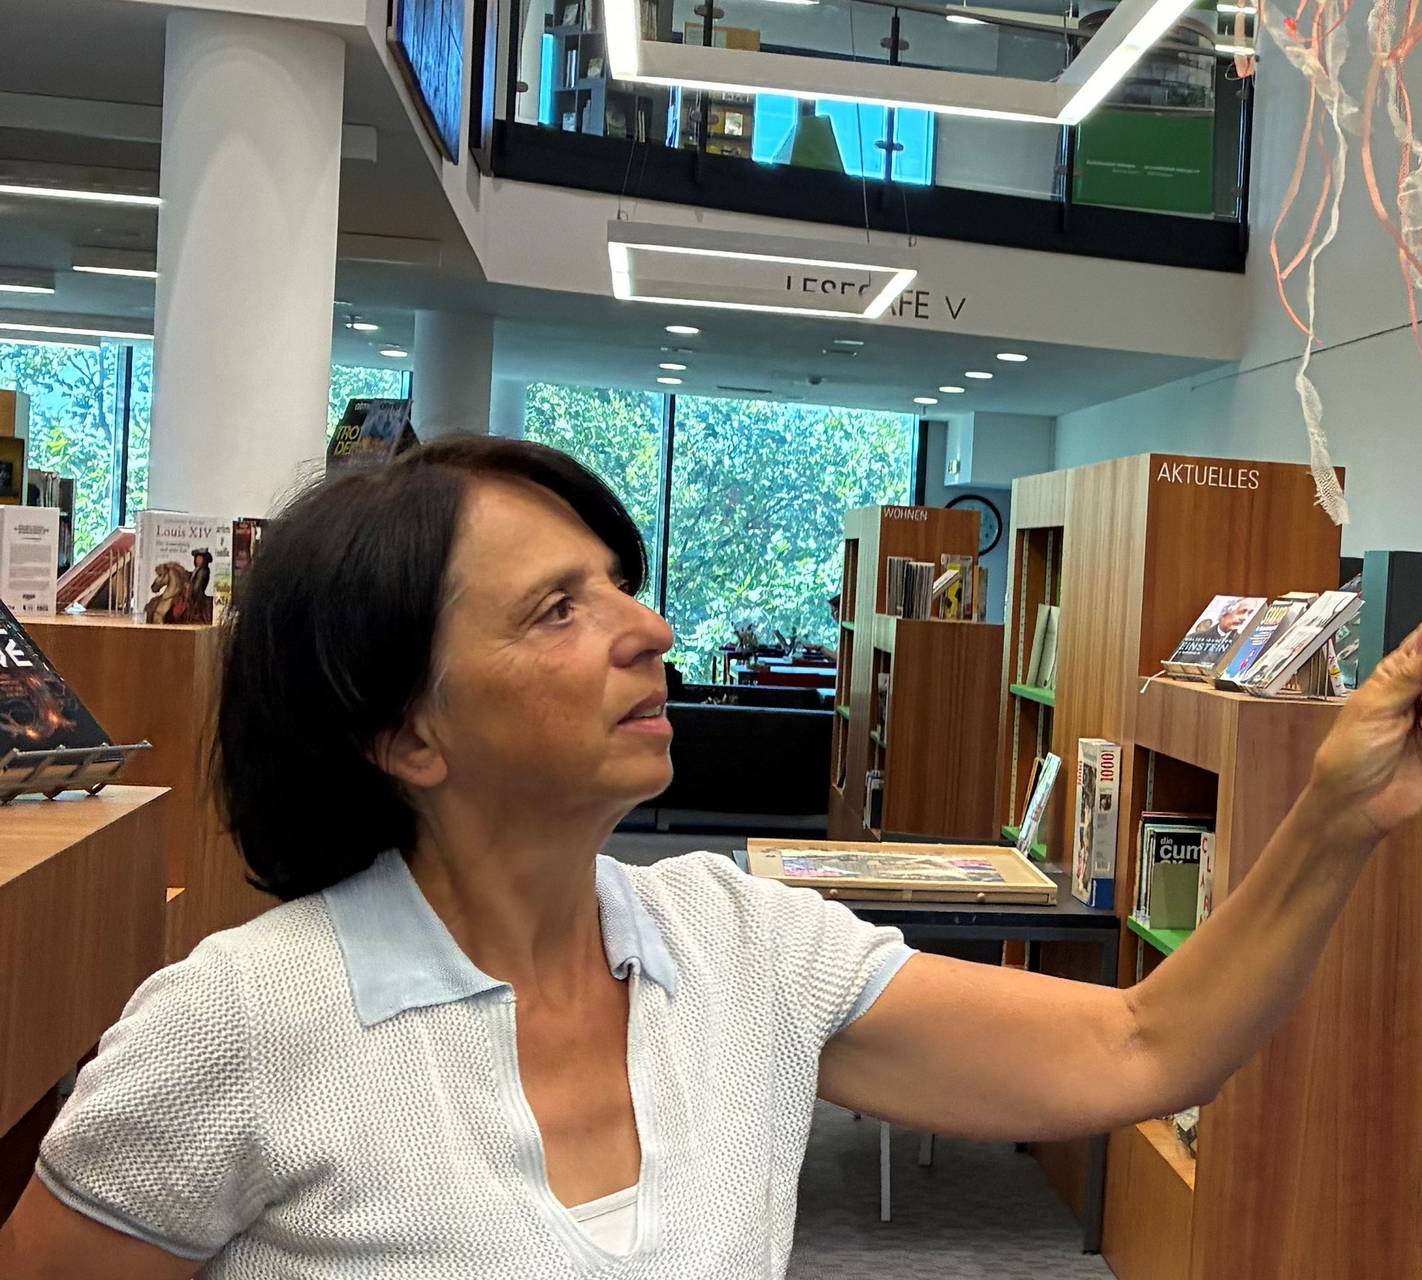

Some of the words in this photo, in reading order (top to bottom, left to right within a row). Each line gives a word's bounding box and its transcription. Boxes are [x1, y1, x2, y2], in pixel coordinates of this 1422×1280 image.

[786, 275, 930, 319] LESFE
[1157, 462, 1260, 489] AKTUELLES
[883, 507, 928, 520] WOHNEN
[156, 525, 186, 538] Louis
[189, 527, 212, 538] XIV
[1180, 641, 1230, 652] EINSTEIN
[1100, 751, 1115, 782] 1000
